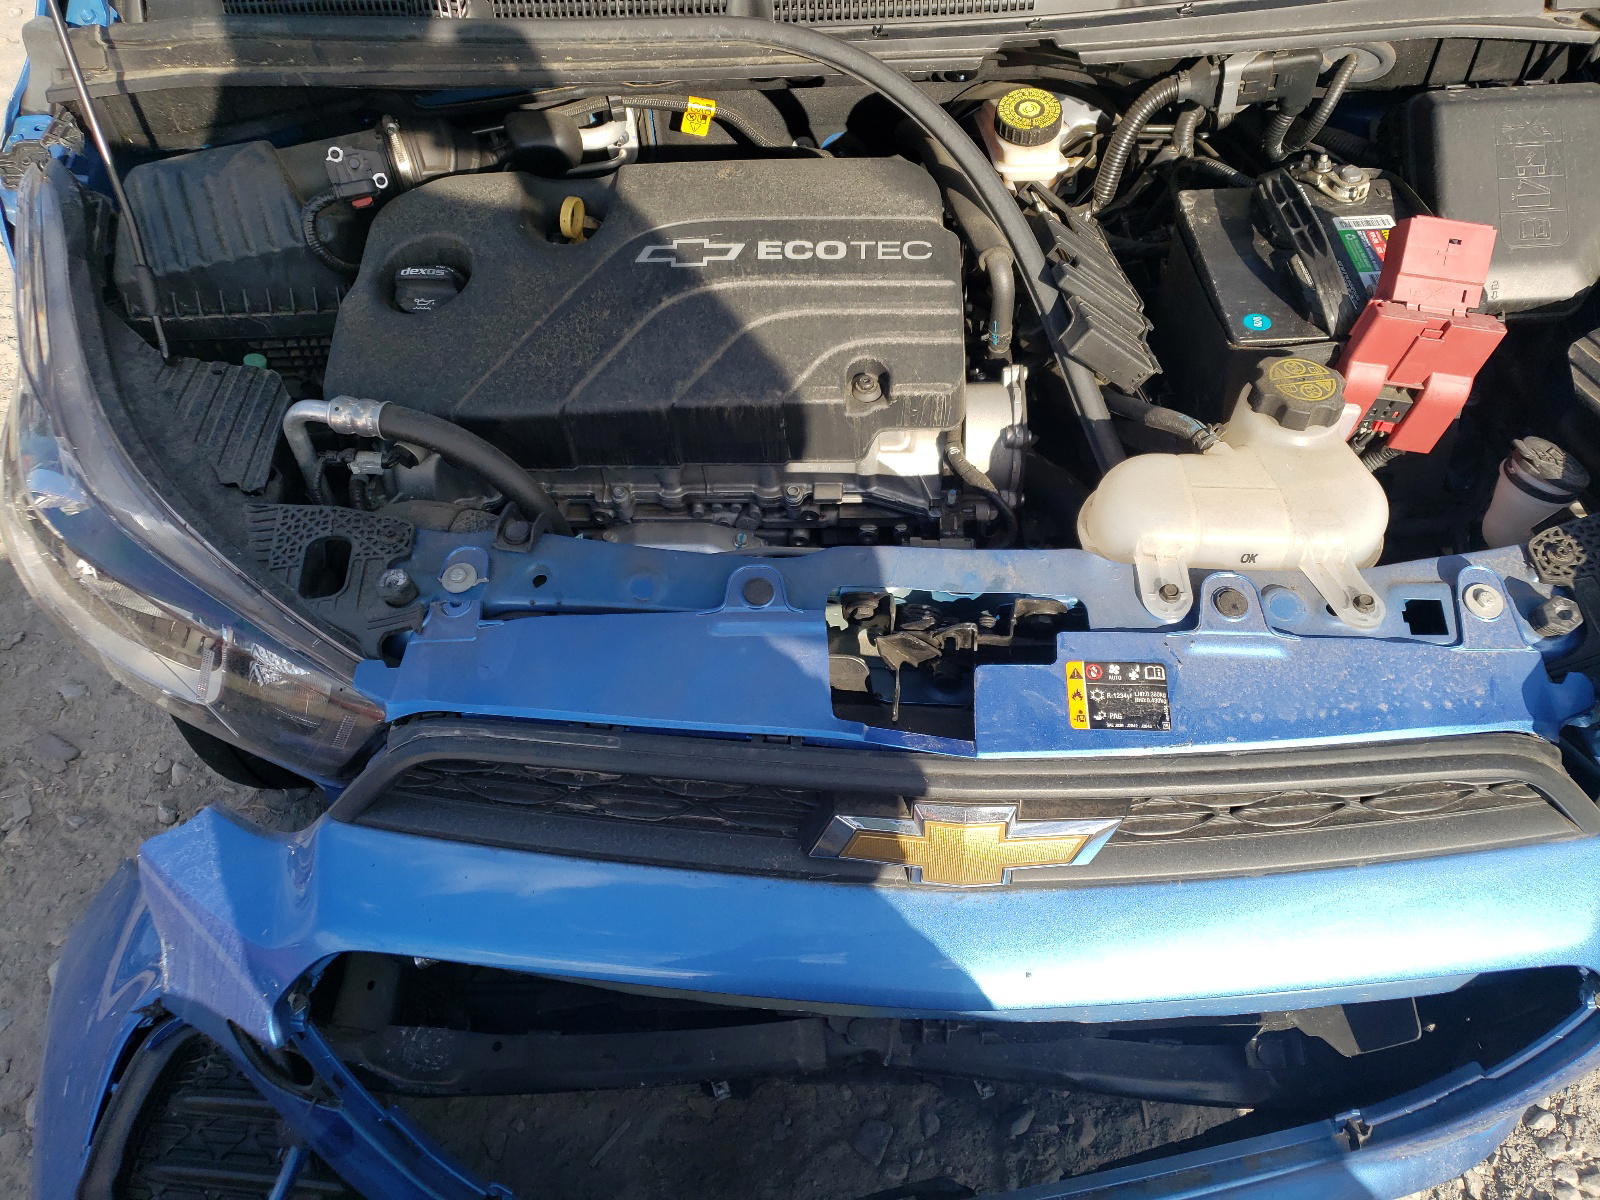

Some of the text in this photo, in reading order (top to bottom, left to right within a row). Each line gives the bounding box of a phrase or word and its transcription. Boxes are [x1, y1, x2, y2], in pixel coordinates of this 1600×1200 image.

[756, 240, 933, 261] ECOTEC
[400, 267, 445, 276] dexos
[1240, 553, 1259, 563] OK
[1109, 712, 1123, 720] PAG
